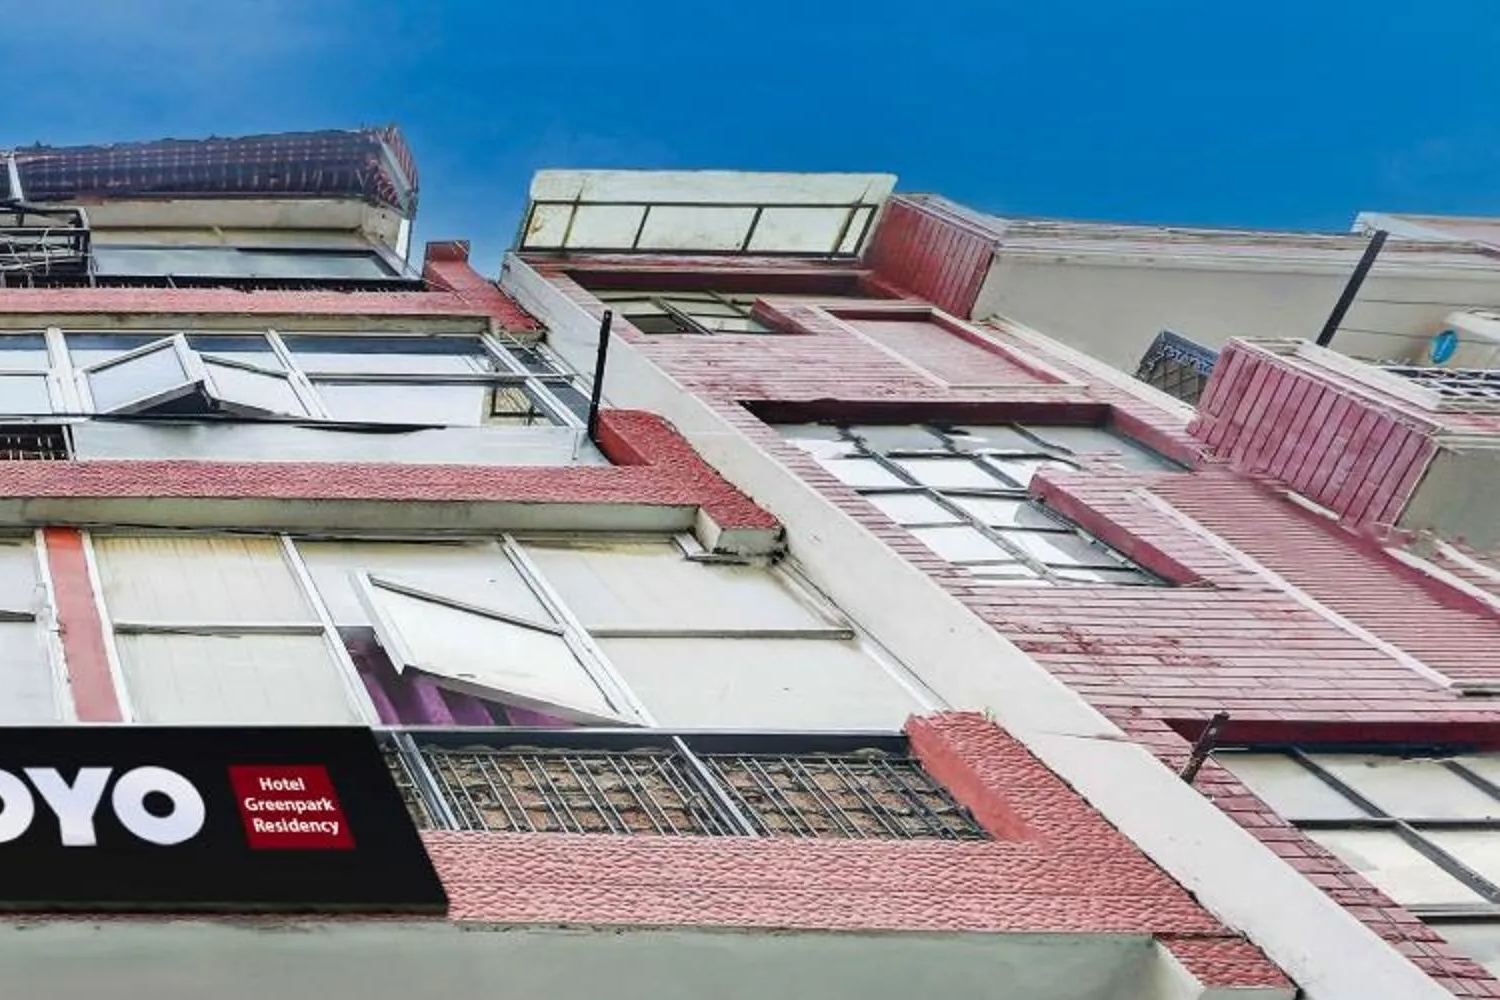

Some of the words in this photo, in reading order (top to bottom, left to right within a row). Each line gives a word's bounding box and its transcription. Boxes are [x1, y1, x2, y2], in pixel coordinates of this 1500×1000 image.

[259, 777, 305, 791] Hotel
[244, 797, 336, 814] Greenpark
[253, 818, 339, 836] Residency
